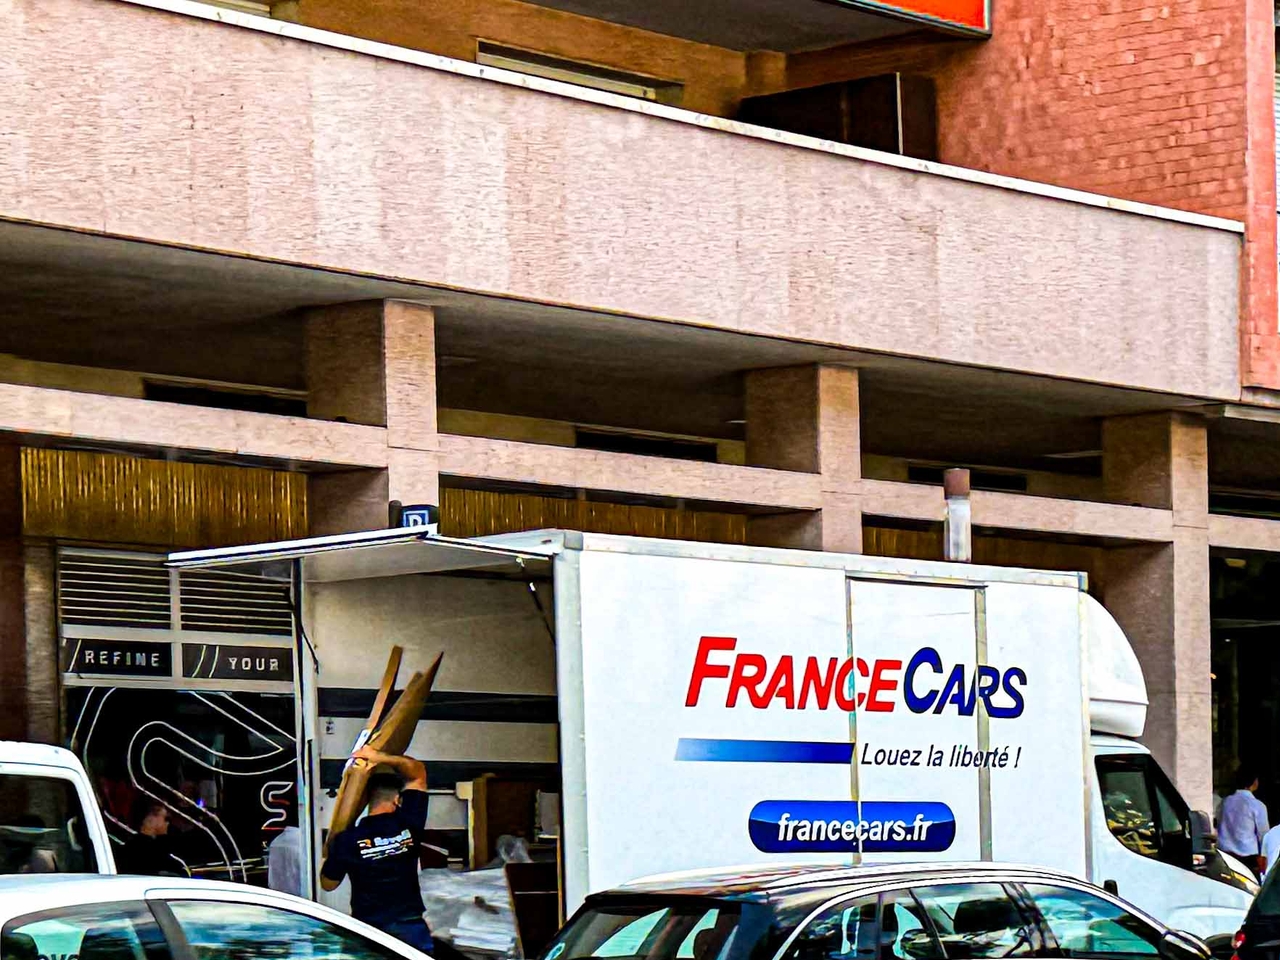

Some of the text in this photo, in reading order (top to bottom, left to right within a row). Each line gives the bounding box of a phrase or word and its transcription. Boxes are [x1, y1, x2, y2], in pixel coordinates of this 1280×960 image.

[85, 650, 161, 667] REFINE
[228, 657, 279, 671] YOUR
[861, 742, 921, 767] Louez
[926, 744, 942, 767] la
[949, 744, 1009, 769] liberté
[777, 813, 934, 842] francecars.fr
